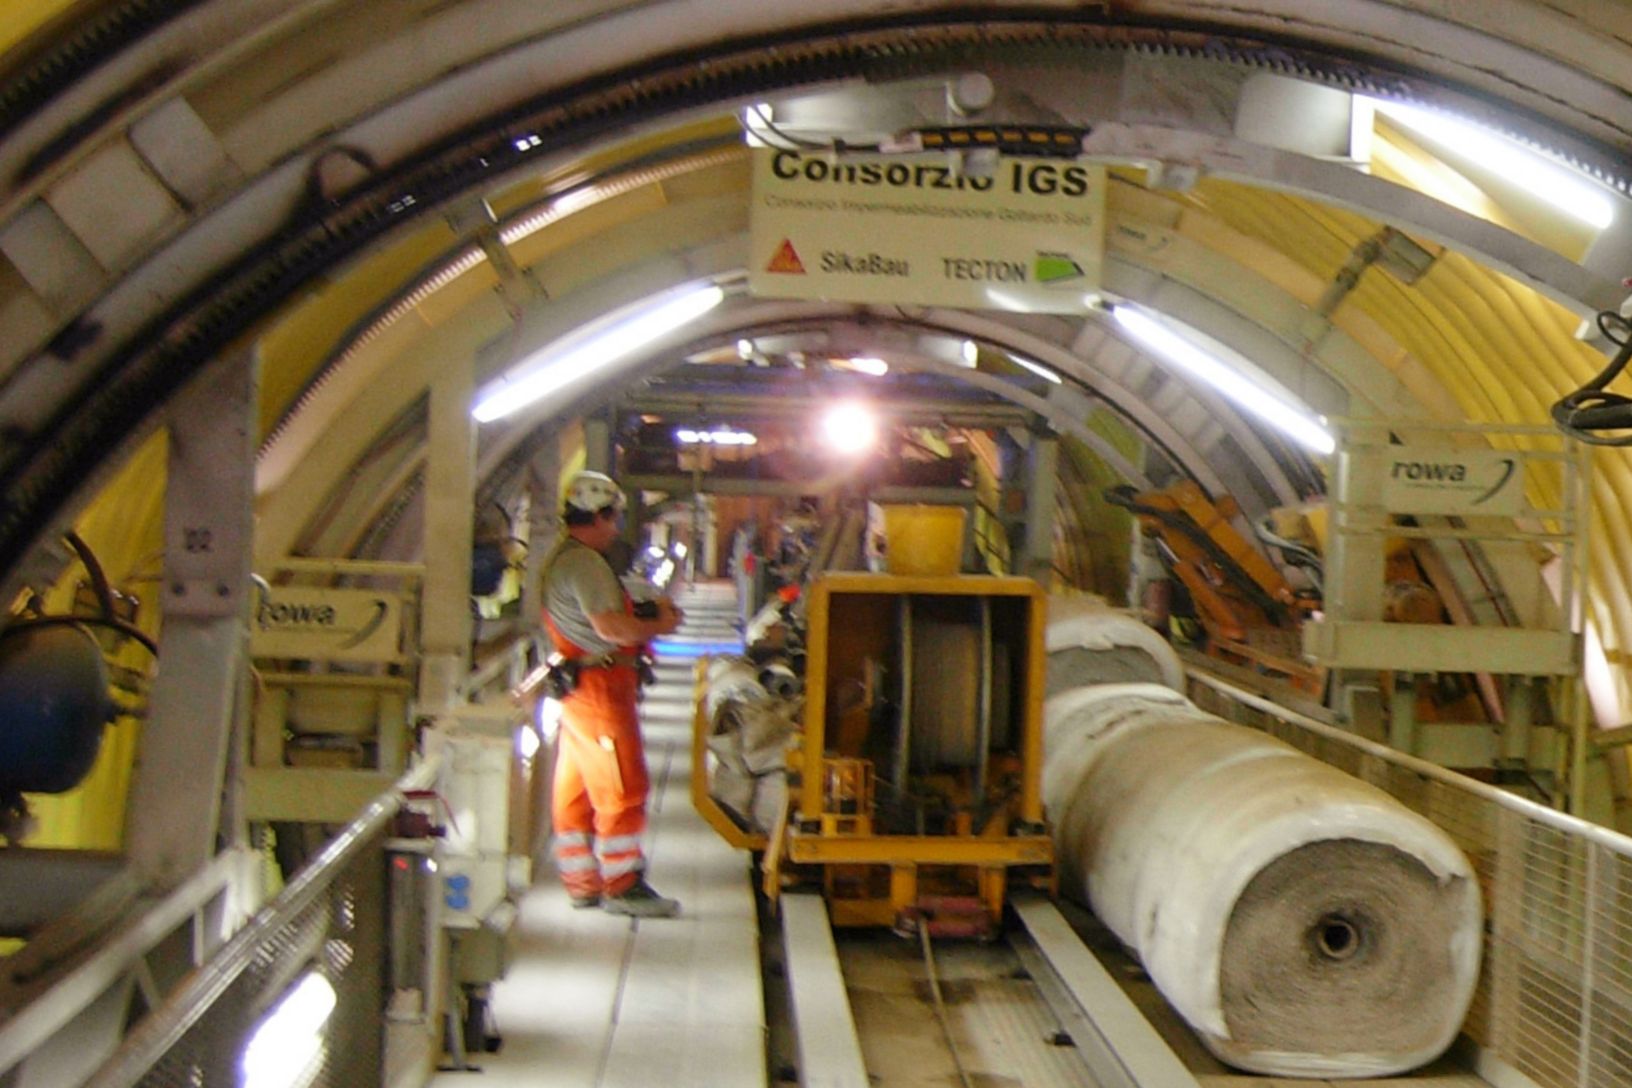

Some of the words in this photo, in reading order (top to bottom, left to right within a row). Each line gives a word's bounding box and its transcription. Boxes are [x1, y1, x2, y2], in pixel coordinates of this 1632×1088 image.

[1013, 163, 1088, 197] IGS
[820, 250, 909, 278] SikaBau
[943, 257, 1027, 283] TECTON
[1391, 461, 1466, 482] rowa
